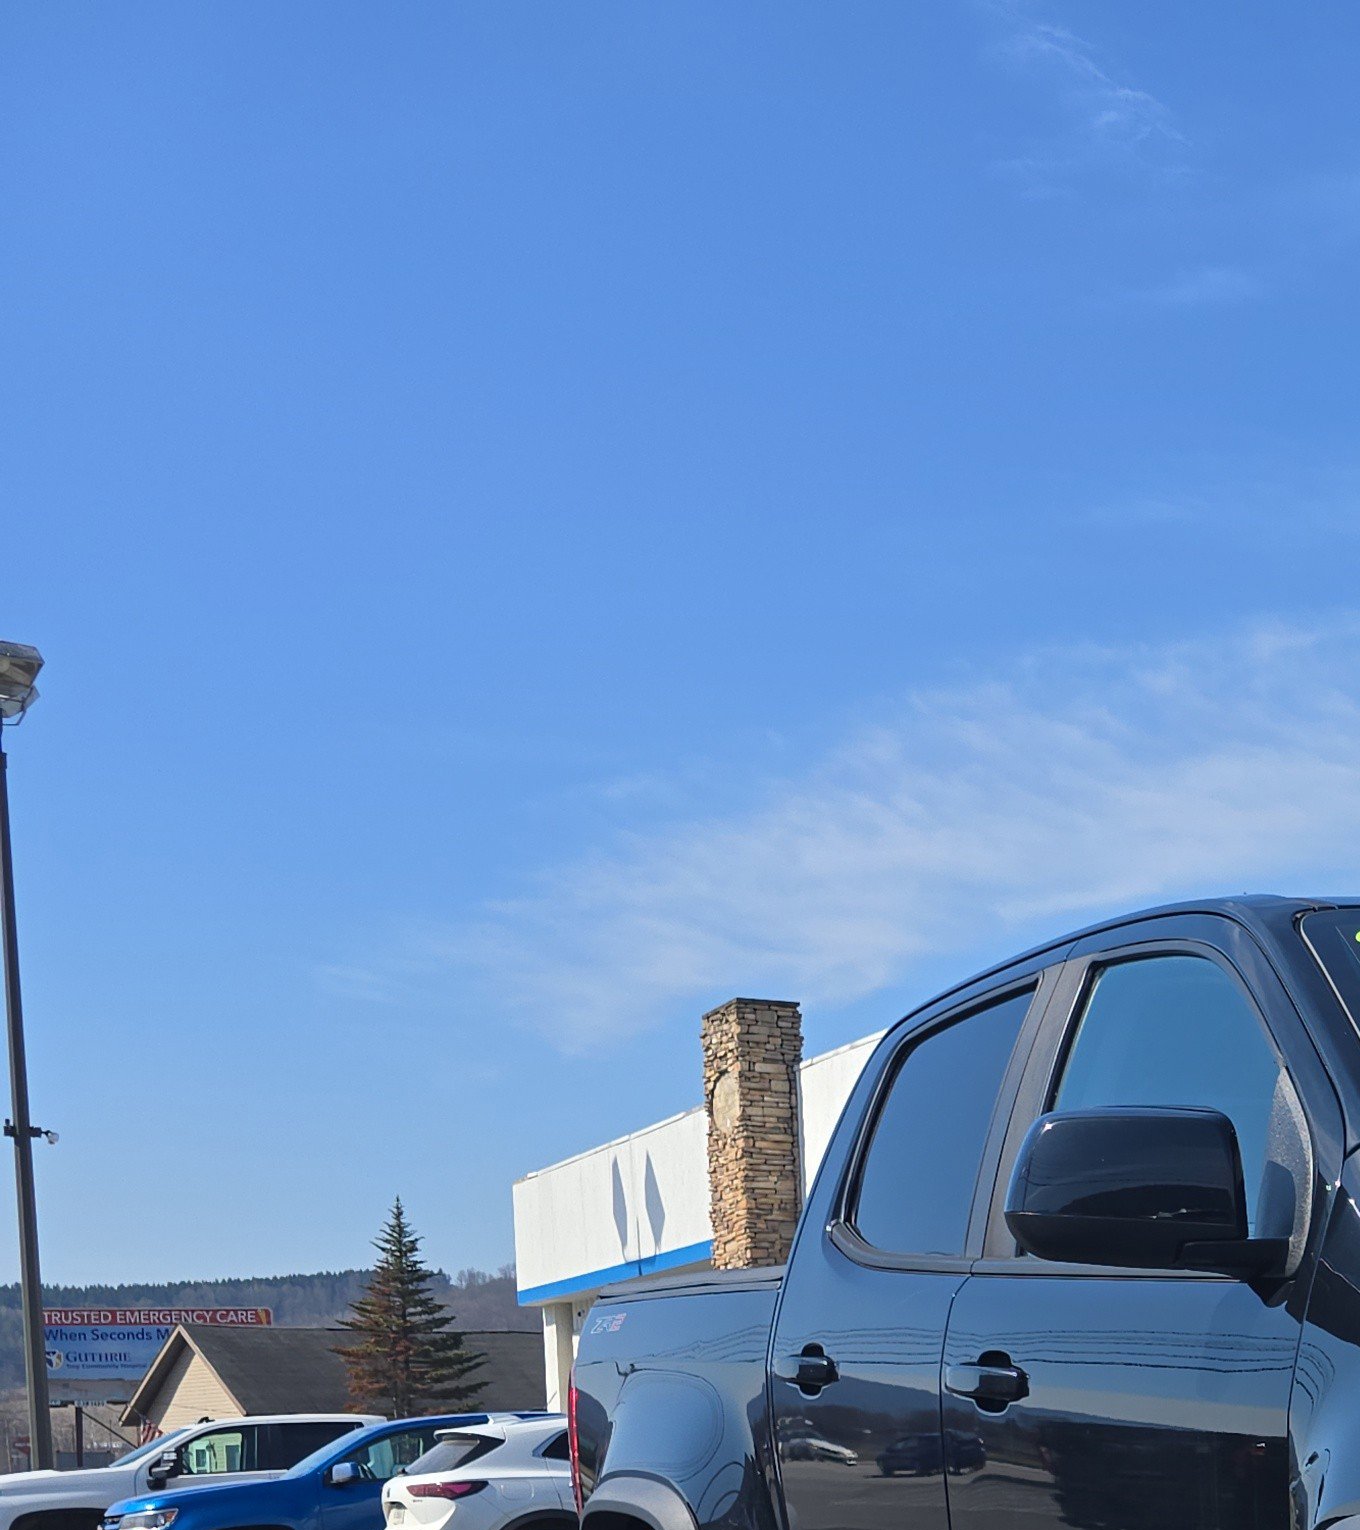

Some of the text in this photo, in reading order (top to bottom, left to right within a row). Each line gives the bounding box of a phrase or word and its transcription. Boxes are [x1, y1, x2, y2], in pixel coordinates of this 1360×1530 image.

[43, 1310, 257, 1324] TRUSTED EMERGENCY CARE
[45, 1328, 87, 1341] When
[91, 1328, 152, 1341] Seconds
